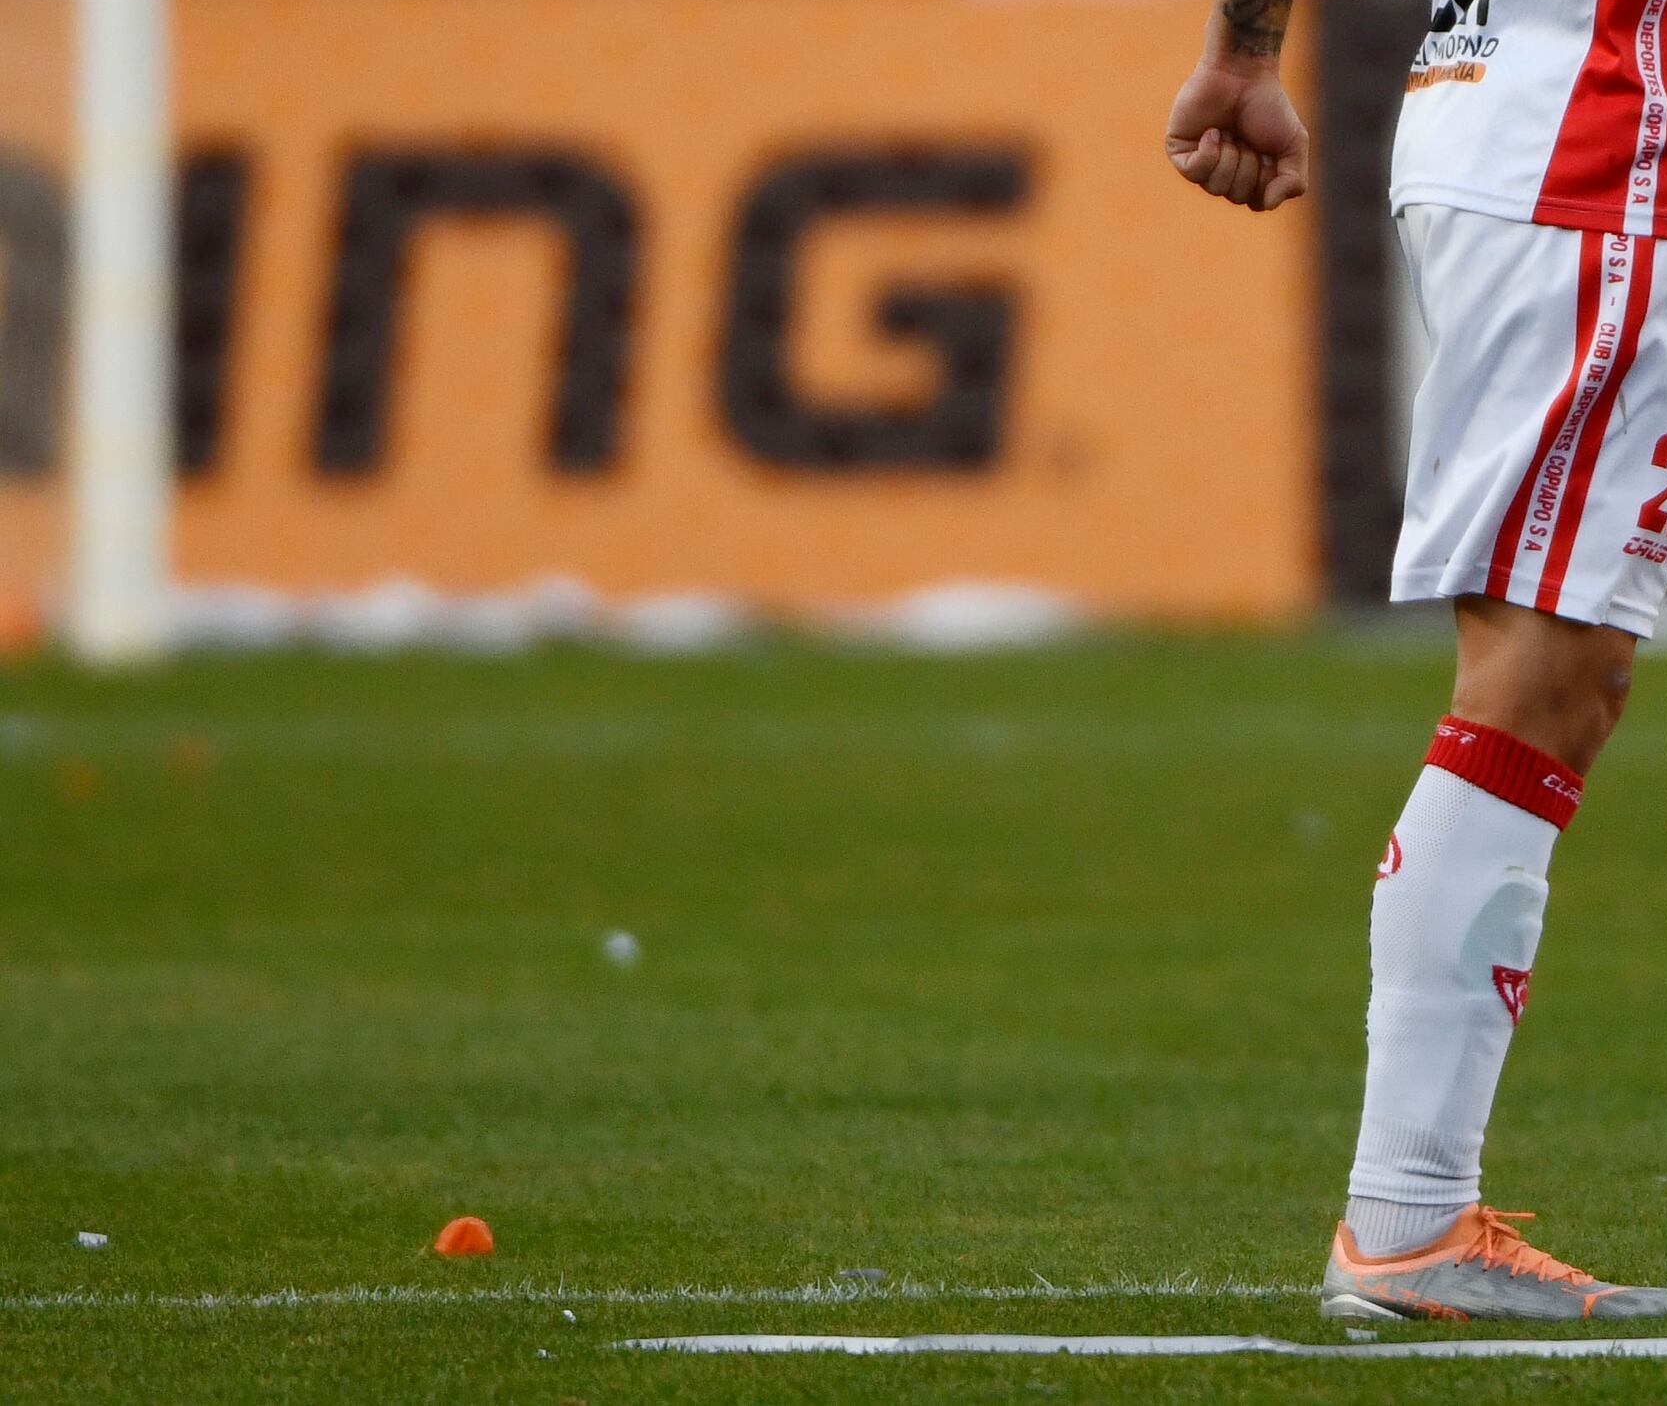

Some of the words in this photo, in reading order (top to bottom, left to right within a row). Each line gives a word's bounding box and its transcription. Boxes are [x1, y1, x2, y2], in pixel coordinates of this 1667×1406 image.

[1640, 21, 1663, 97] DEPORTES
[1634, 102, 1665, 171] COPIAPO
[1631, 192, 1649, 204] A
[1633, 177, 1651, 187] S
[1593, 322, 1617, 359] CLUB
[1586, 362, 1607, 382] DE
[1554, 385, 1601, 452] DEPORTES
[1533, 455, 1567, 522] COPIAPO
